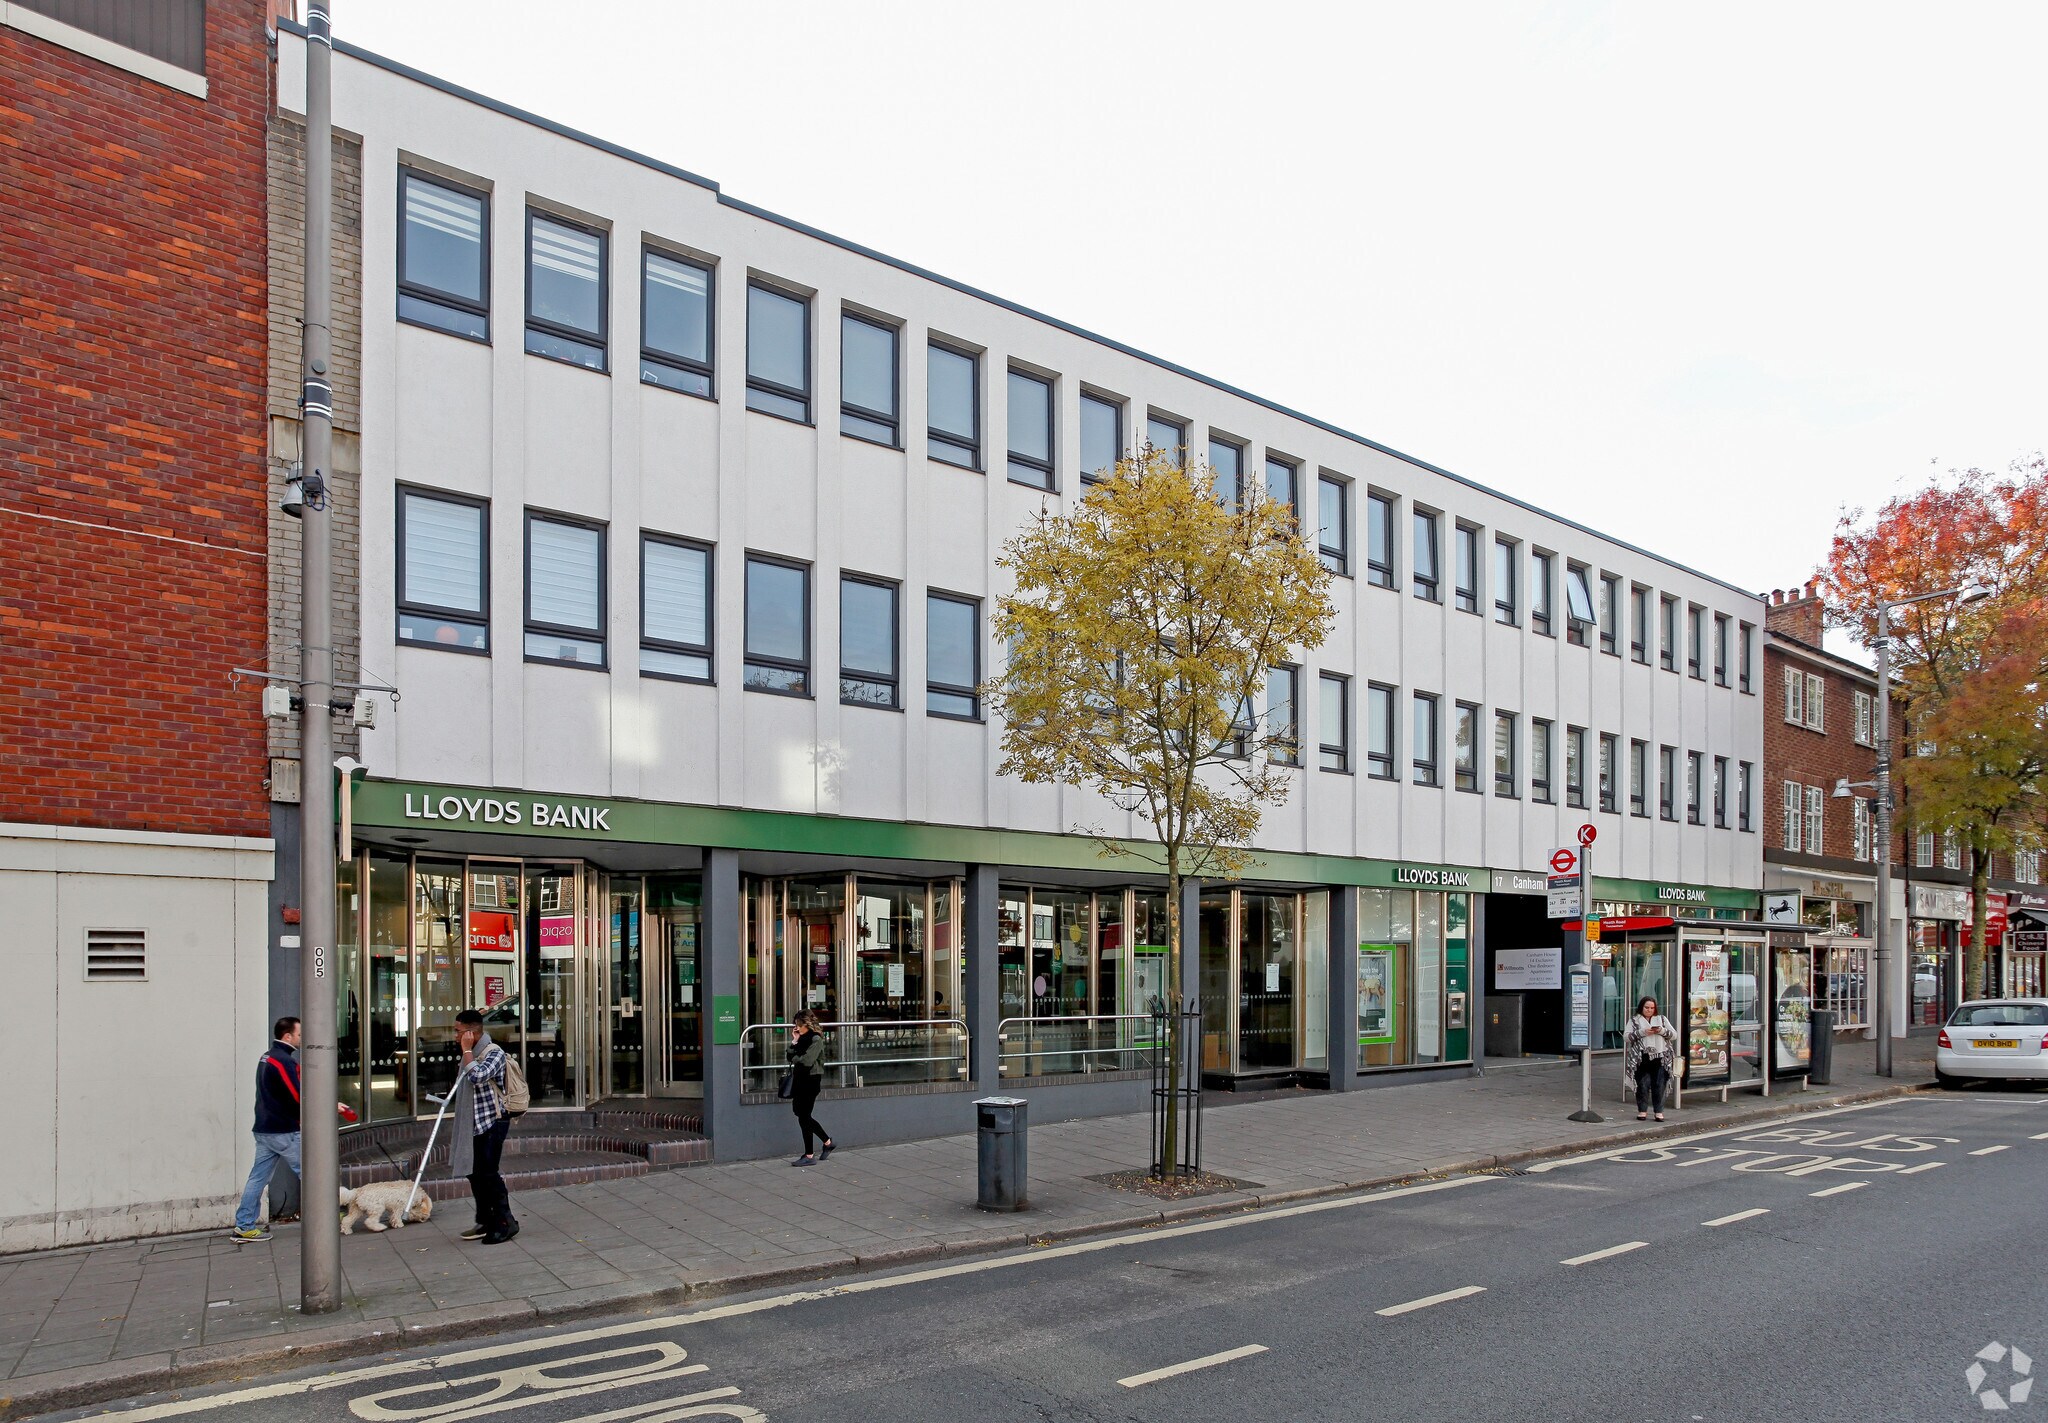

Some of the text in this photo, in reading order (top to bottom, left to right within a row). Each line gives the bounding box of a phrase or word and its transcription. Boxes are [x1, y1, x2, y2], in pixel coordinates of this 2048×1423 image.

[405, 793, 611, 831] LLOYDS BANK
[1580, 827, 1592, 842] K
[1398, 868, 1470, 886] LLOYDS BANK
[1494, 876, 1503, 887] 17
[1513, 875, 1544, 890] Canham
[1659, 887, 1706, 902] LLOYDS BANK
[315, 947, 324, 978] 005
[1732, 1128, 1960, 1152] BUS
[1607, 1146, 1906, 1176] STOP
